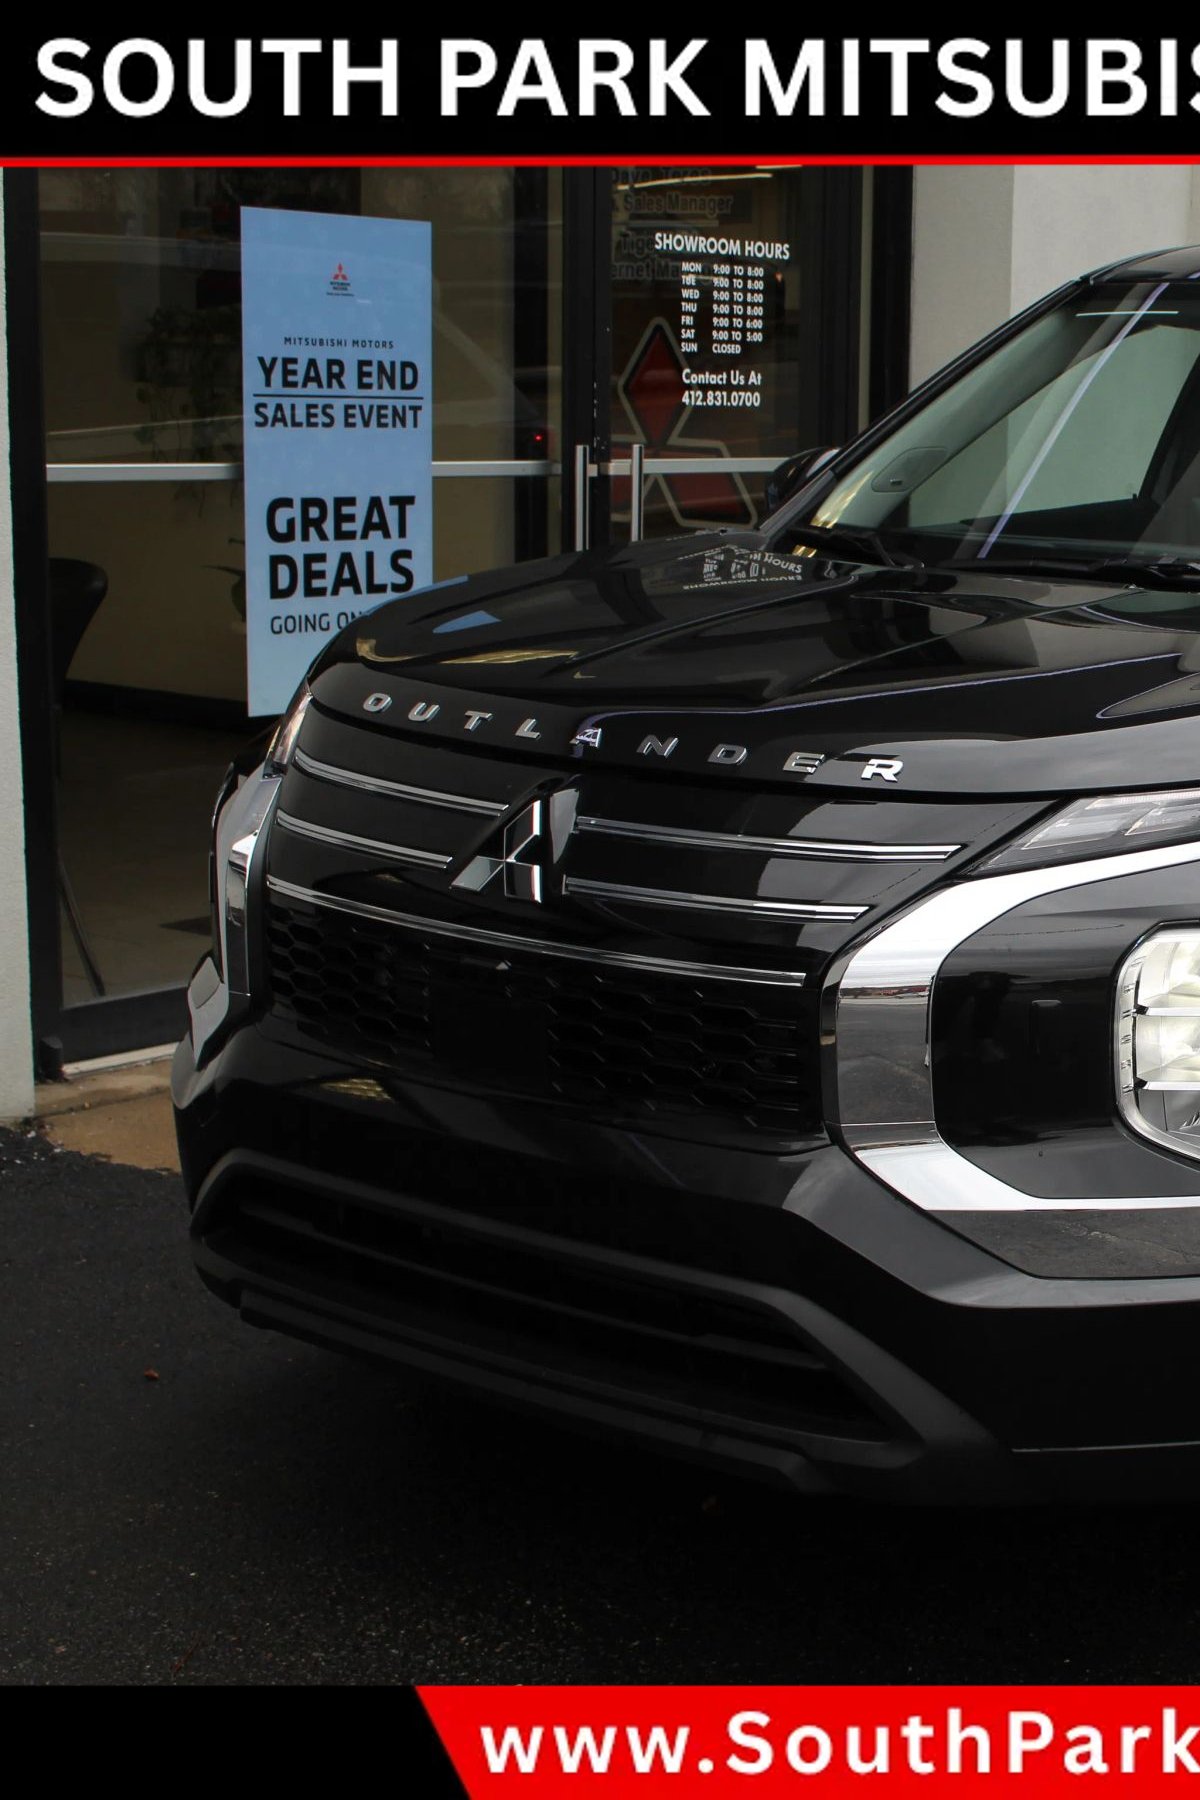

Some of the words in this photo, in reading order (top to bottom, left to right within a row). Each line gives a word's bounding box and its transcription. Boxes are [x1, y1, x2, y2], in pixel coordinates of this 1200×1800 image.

[655, 232, 741, 257] SHOWROOM
[745, 239, 790, 260] HOURS
[682, 262, 702, 272] MON
[713, 264, 730, 274] 9:00
[734, 266, 744, 276] TO
[747, 266, 764, 277] 8:00
[682, 276, 696, 286] TUE
[713, 278, 730, 288] 9:00
[733, 279, 743, 289] TO
[747, 280, 764, 290] 8:00
[682, 289, 700, 299] WED
[713, 291, 730, 301] 9:00
[733, 292, 743, 302] TO
[747, 293, 764, 303] 8:00
[681, 302, 697, 312] THU
[713, 304, 730, 314] 9:00
[733, 305, 743, 315] TO
[747, 306, 764, 316] 8:00
[681, 315, 694, 326] FRI
[713, 317, 730, 327] 9:00
[733, 318, 743, 328] TO
[746, 319, 763, 329] 6:00
[284, 337, 347, 347] MITSUBISHI
[353, 340, 394, 349] MOTORS
[681, 328, 696, 339] SAT
[712, 330, 728, 340] 9:00
[732, 331, 742, 341] TO
[746, 332, 763, 342] 5:00
[681, 342, 698, 352] SUN
[712, 343, 742, 354] CLOSED
[257, 356, 346, 389] YEAR
[357, 359, 419, 391] END
[682, 368, 727, 385] Contact
[731, 370, 745, 386] Us
[748, 371, 762, 386] At
[681, 390, 761, 407] 412.831.0700
[254, 402, 335, 428] SALES
[344, 404, 423, 428] EVENT
[266, 495, 416, 544] GREAT
[269, 548, 414, 599] DEALS
[271, 612, 330, 634] GOING
[363, 692, 904, 783] OUTLANDER
